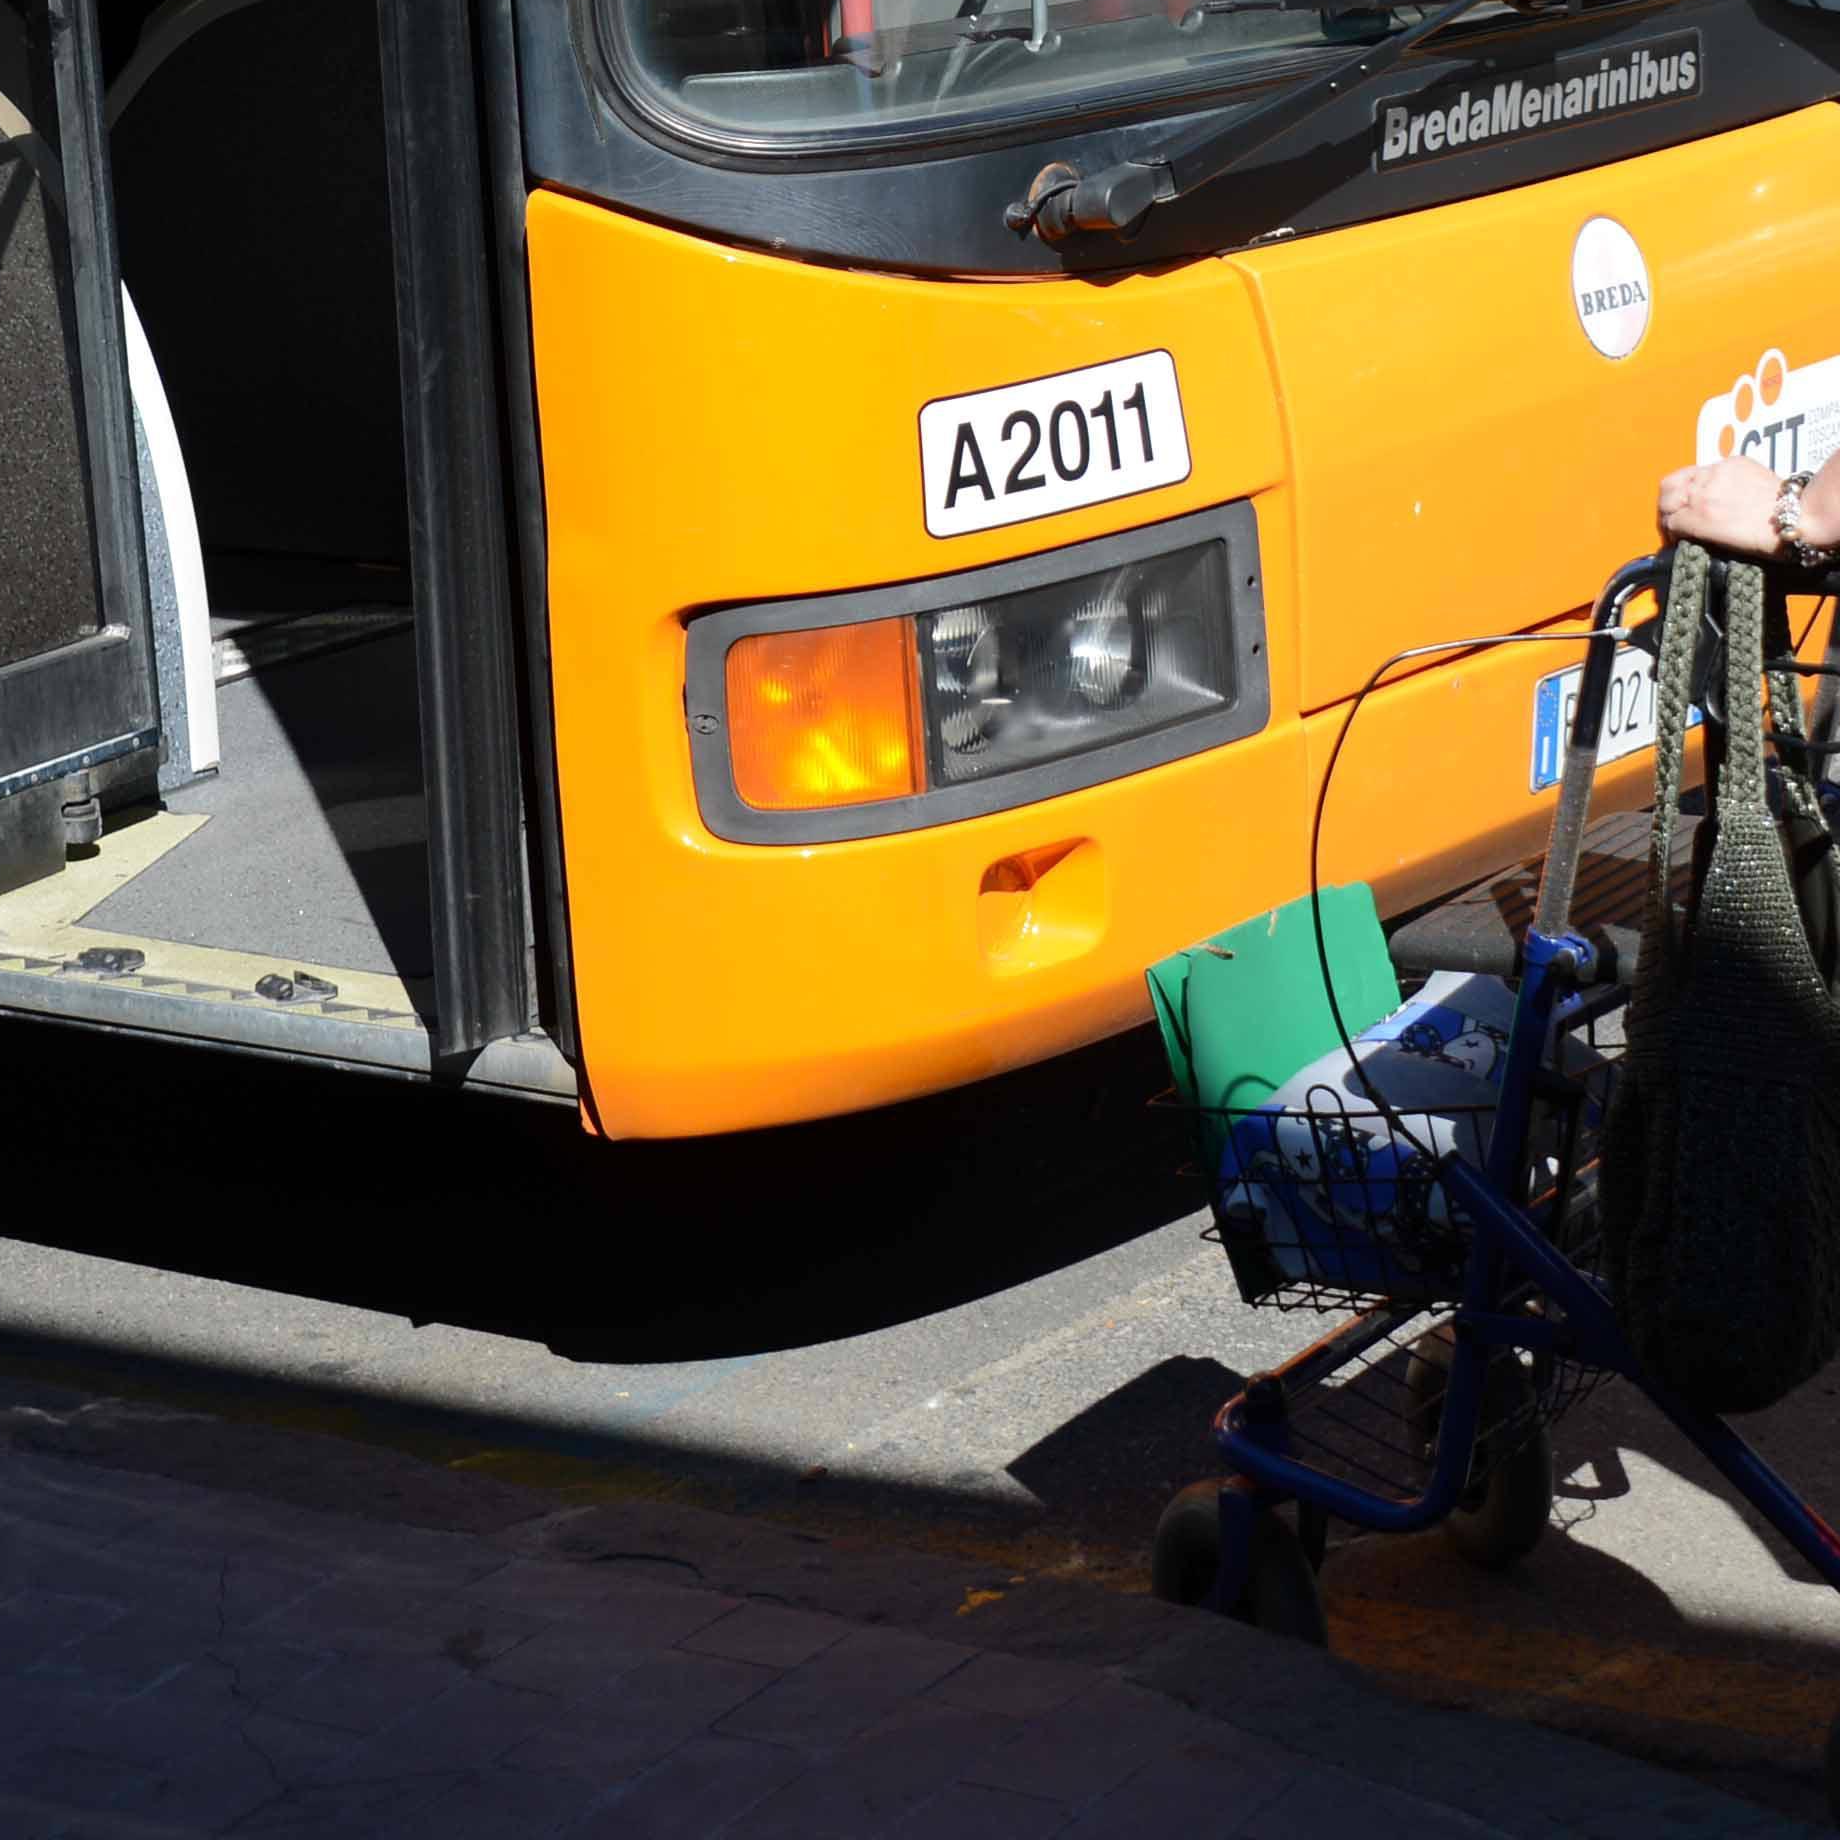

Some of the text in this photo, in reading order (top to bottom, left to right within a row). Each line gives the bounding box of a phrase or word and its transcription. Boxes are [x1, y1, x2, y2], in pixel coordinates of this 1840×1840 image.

[1382, 50, 1697, 161] BredaMenarinibus
[1580, 279, 1647, 317] BREDA
[943, 381, 1155, 510] A2011
